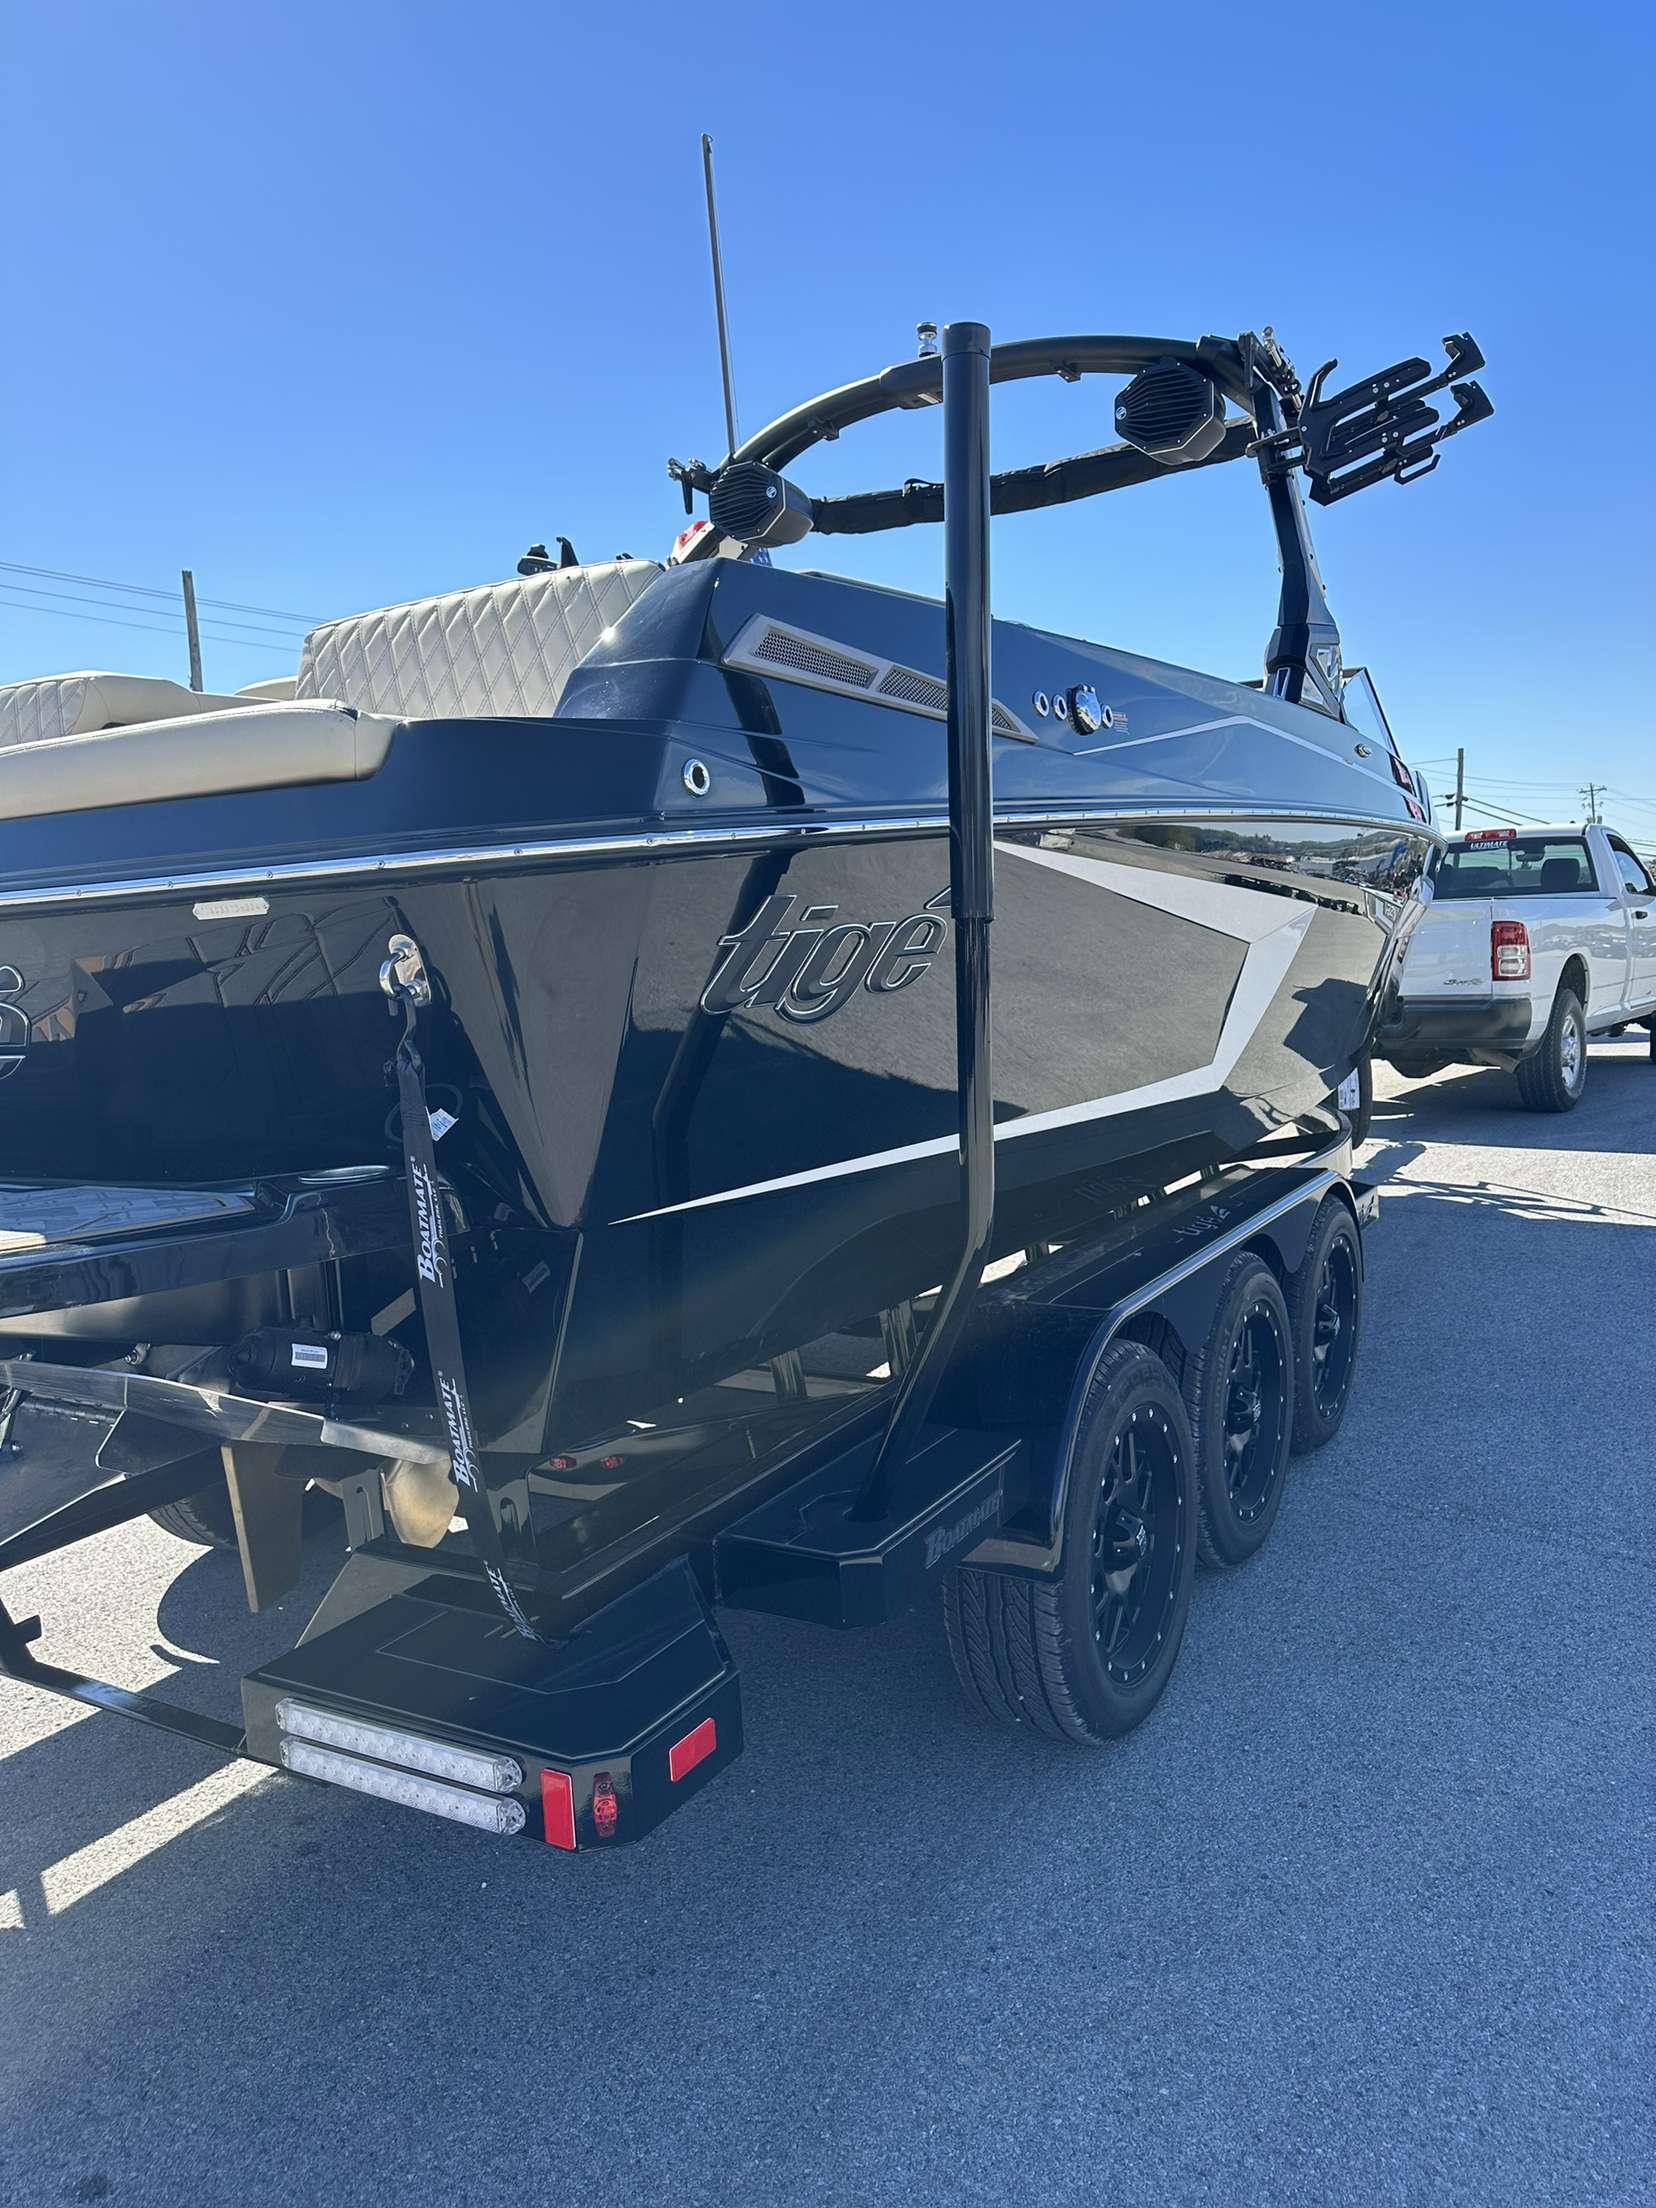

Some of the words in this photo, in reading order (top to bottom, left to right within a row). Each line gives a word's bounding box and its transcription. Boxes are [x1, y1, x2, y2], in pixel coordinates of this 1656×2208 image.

[700, 884, 951, 1025] tigé
[411, 1161, 437, 1283] BOATMATE
[440, 1377, 471, 1488] BOATMATE
